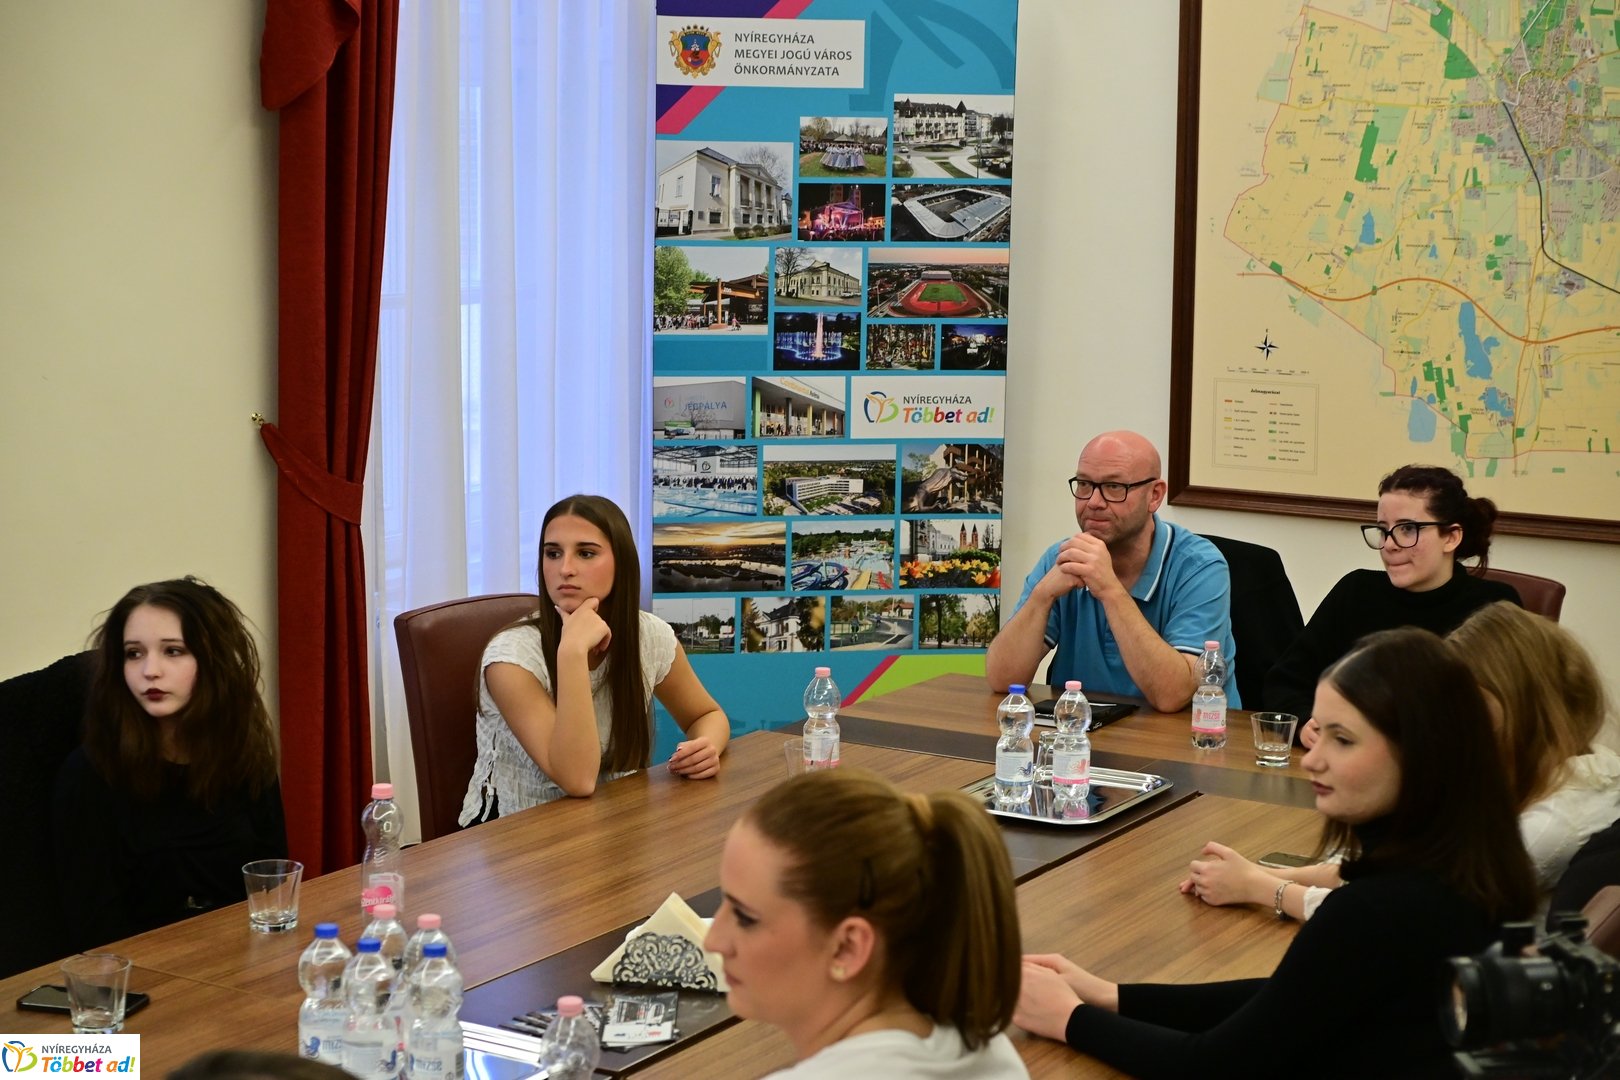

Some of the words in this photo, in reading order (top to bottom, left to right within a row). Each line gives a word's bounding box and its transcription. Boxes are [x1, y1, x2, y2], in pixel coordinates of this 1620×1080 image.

[734, 31, 815, 44] NYÍREGYHÁZA
[734, 49, 778, 59] MEGYEI
[780, 48, 811, 60] JOGÚ
[814, 48, 852, 60] VÁROS
[734, 62, 840, 76] ÖNKORMÁNYZATA
[903, 394, 972, 405] NYÍREGYHÁZA
[903, 406, 963, 424] Többet
[966, 406, 996, 424] ad!
